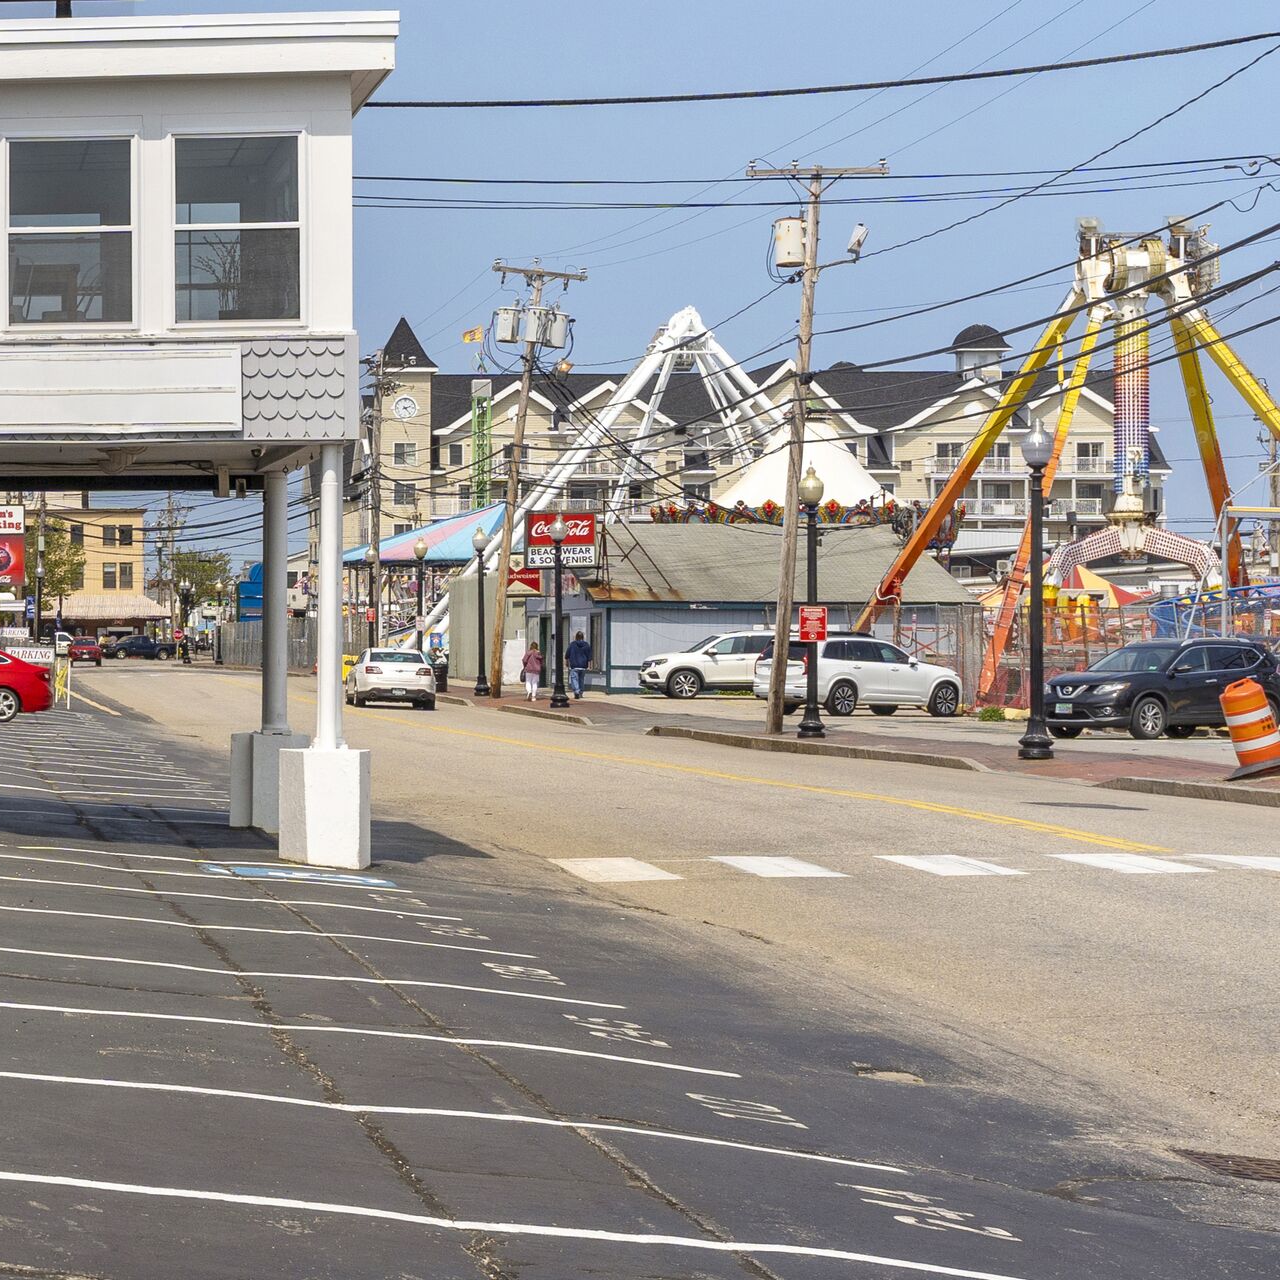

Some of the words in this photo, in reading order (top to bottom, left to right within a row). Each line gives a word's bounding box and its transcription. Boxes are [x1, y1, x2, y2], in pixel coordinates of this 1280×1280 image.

[531, 547, 591, 556] BEACWEAR
[529, 557, 536, 565] &
[0, 629, 28, 637] PARKING
[10, 650, 51, 660] PARKING
